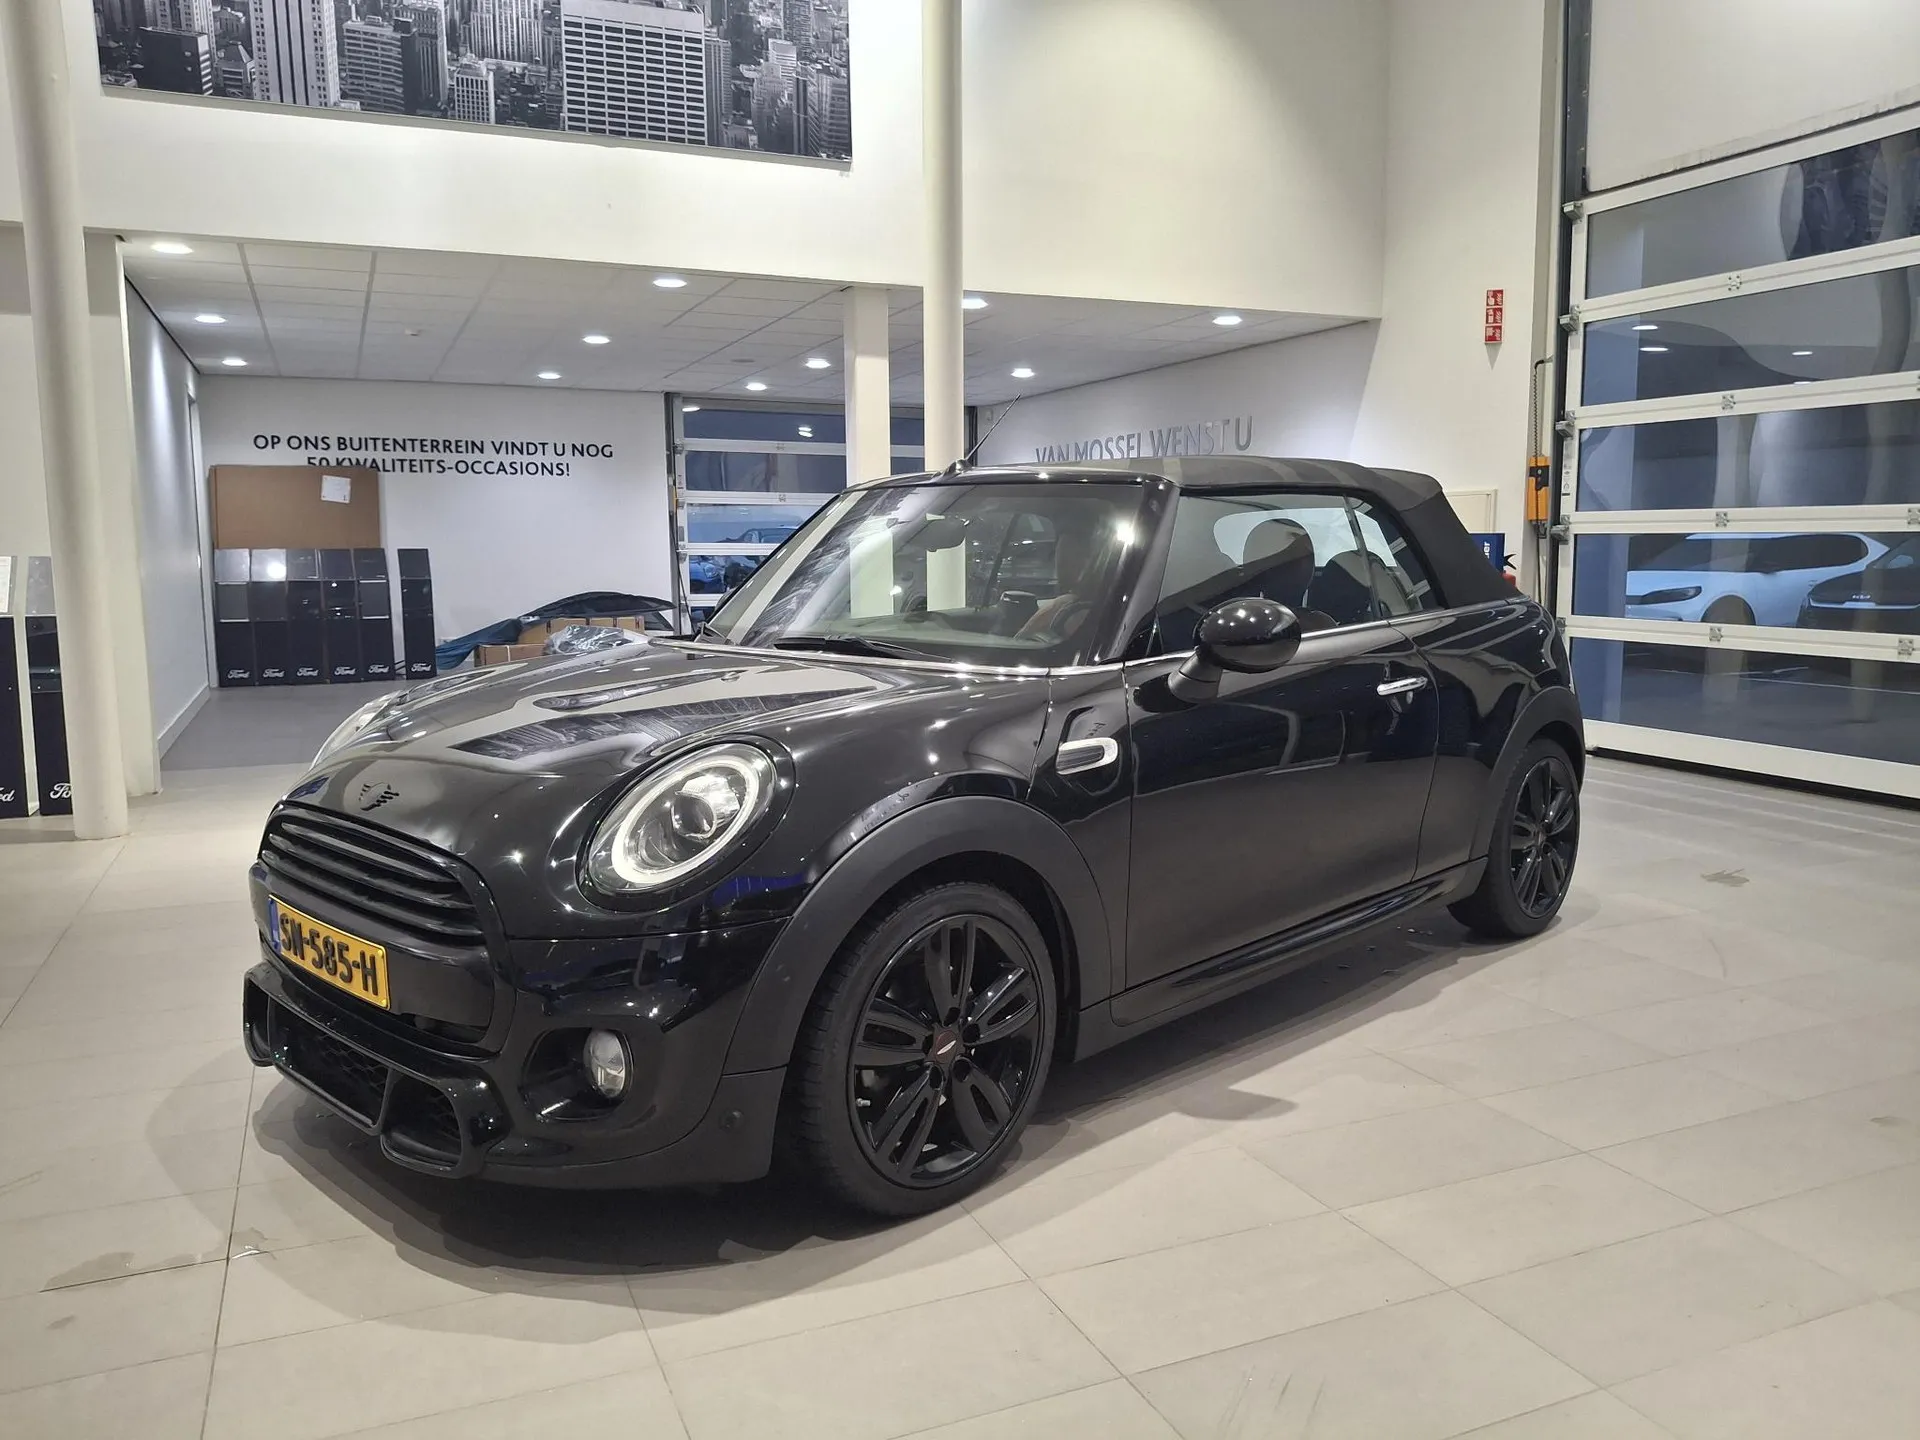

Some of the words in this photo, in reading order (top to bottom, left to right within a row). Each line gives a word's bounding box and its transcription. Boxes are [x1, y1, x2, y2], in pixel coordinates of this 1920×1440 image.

[1035, 443, 1070, 462] VAN
[1234, 415, 1253, 452] U
[253, 434, 282, 450] OP
[286, 435, 331, 451] ONS
[336, 436, 485, 454] BUITENTERREIN
[490, 440, 549, 456] VINDT
[553, 442, 566, 457] U
[571, 443, 614, 458] NOG
[296, 667, 319, 677] Ford
[334, 666, 356, 676] Ford
[368, 664, 390, 674] Ford
[411, 662, 432, 672] Ford
[227, 669, 250, 679] Ford
[262, 668, 286, 678] Ford
[279, 912, 379, 996] SN-585-H
